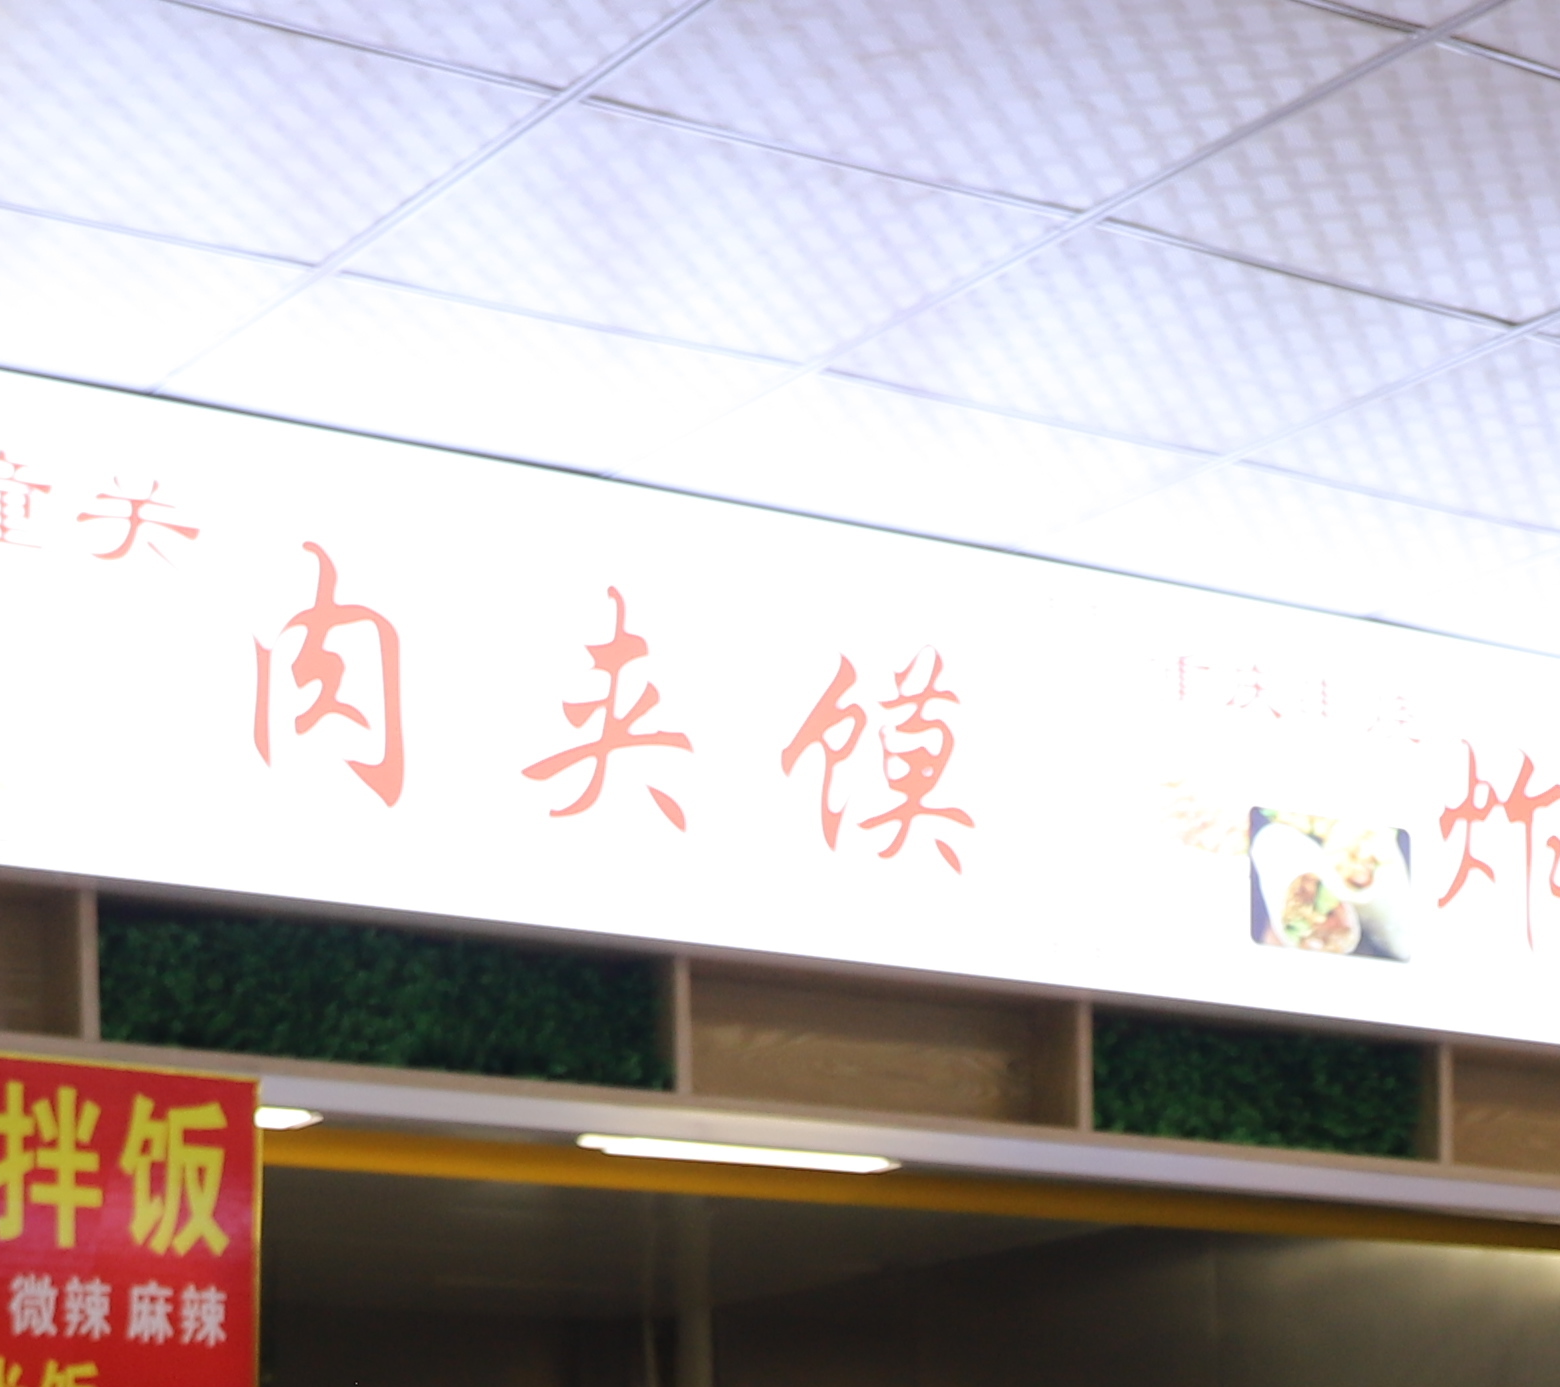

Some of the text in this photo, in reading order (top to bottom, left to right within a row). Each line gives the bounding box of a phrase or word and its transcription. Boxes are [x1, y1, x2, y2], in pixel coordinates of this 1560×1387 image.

[252, 541, 976, 875] 肉夹馍
[9, 1275, 111, 1340] 微辣
[127, 1280, 227, 1348] 麻辣
